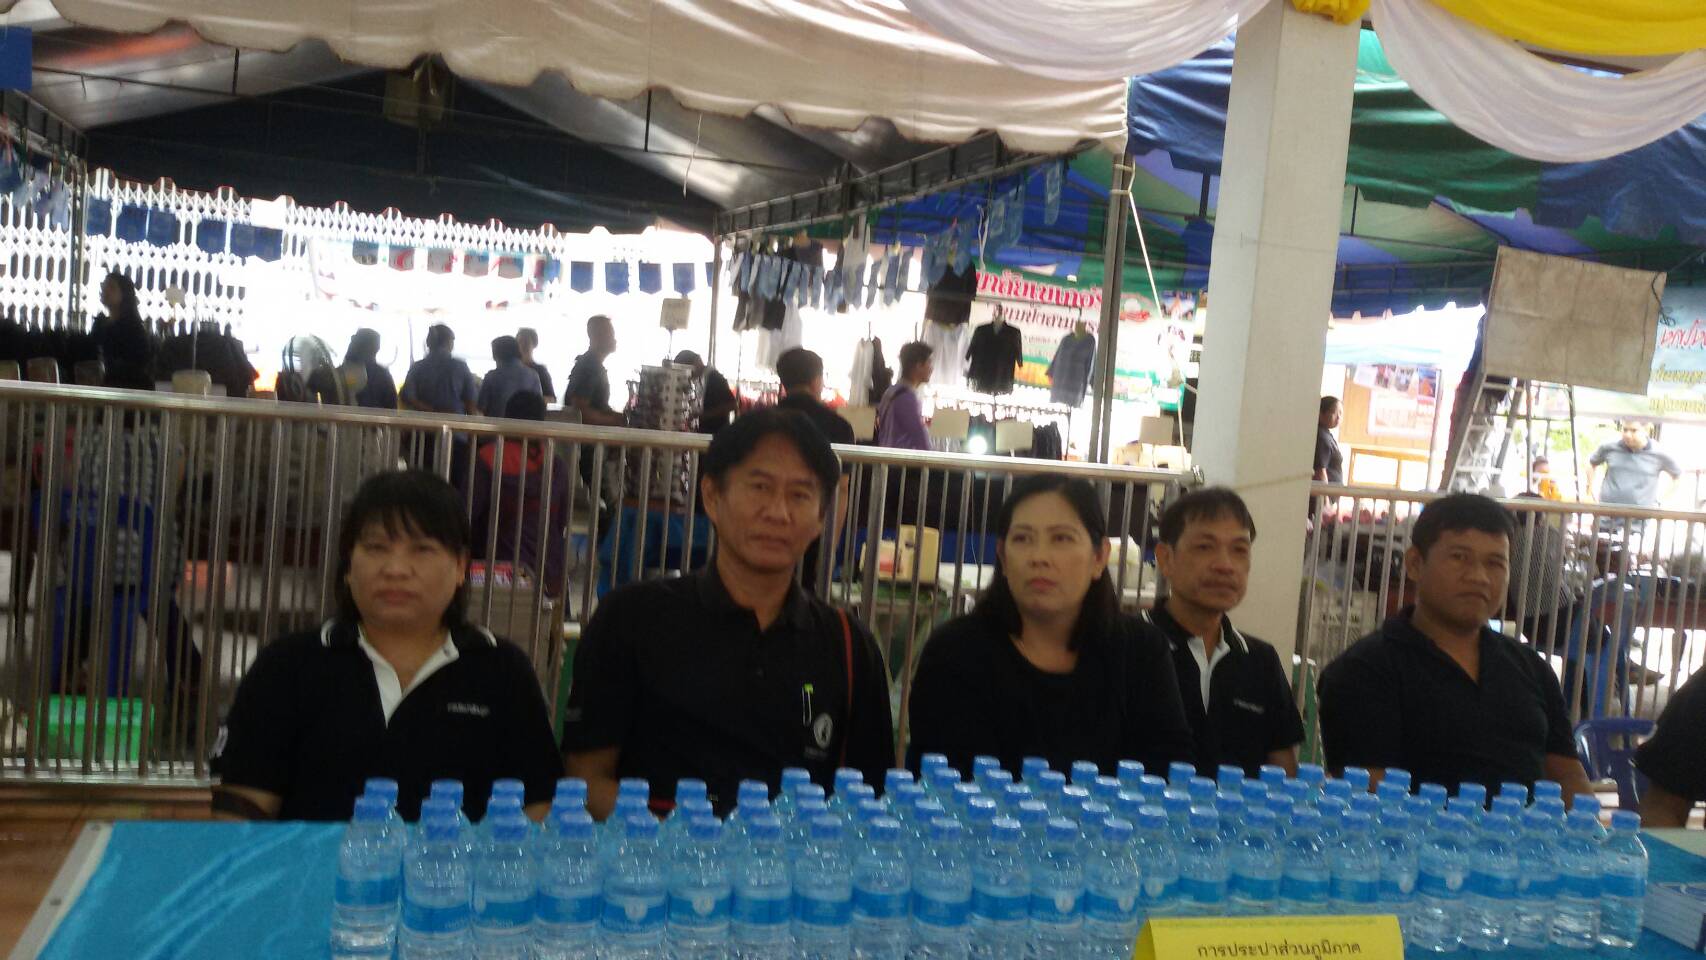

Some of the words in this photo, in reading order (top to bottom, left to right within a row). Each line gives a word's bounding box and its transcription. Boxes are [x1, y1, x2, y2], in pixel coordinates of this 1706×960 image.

[1197, 939, 1361, 960] การประปาส่วนภูมิภาค
